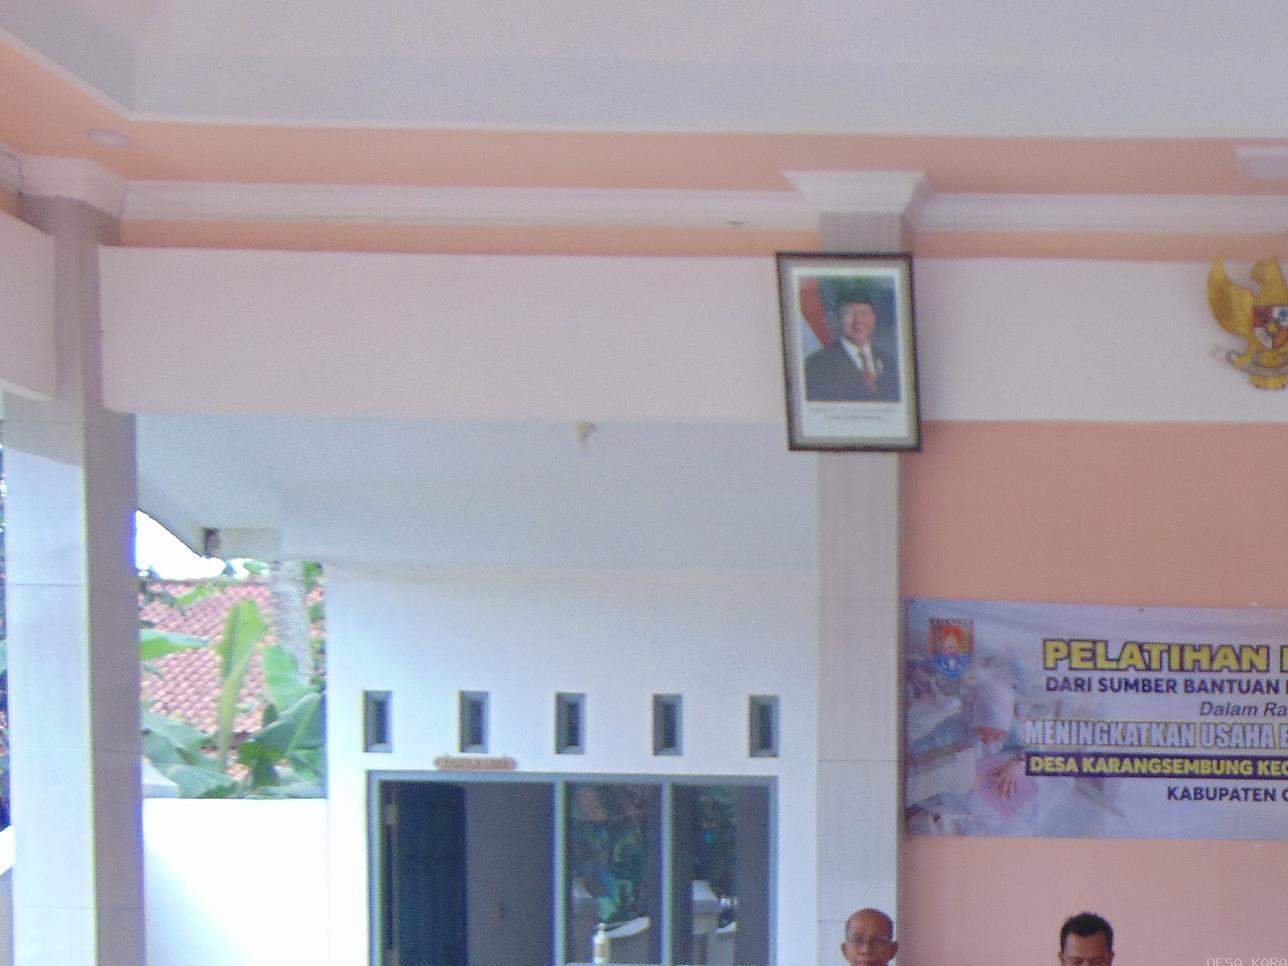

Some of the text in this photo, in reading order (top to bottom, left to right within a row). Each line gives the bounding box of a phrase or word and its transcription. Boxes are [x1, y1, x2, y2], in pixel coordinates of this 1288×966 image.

[1043, 638, 1270, 673] PELATIHAN
[1046, 676, 1092, 692] DARI
[1098, 677, 1177, 693] SUMBER
[1184, 678, 1280, 694] BANTUAN
[1200, 701, 1258, 717] Dalam
[1023, 719, 1197, 747] MENINGKATKAN
[1200, 722, 1276, 748] USAHA
[1030, 756, 1078, 773] DESA
[1082, 757, 1253, 775] KARANGSEMBUNG
[1167, 785, 1276, 802] KABUPATEN
